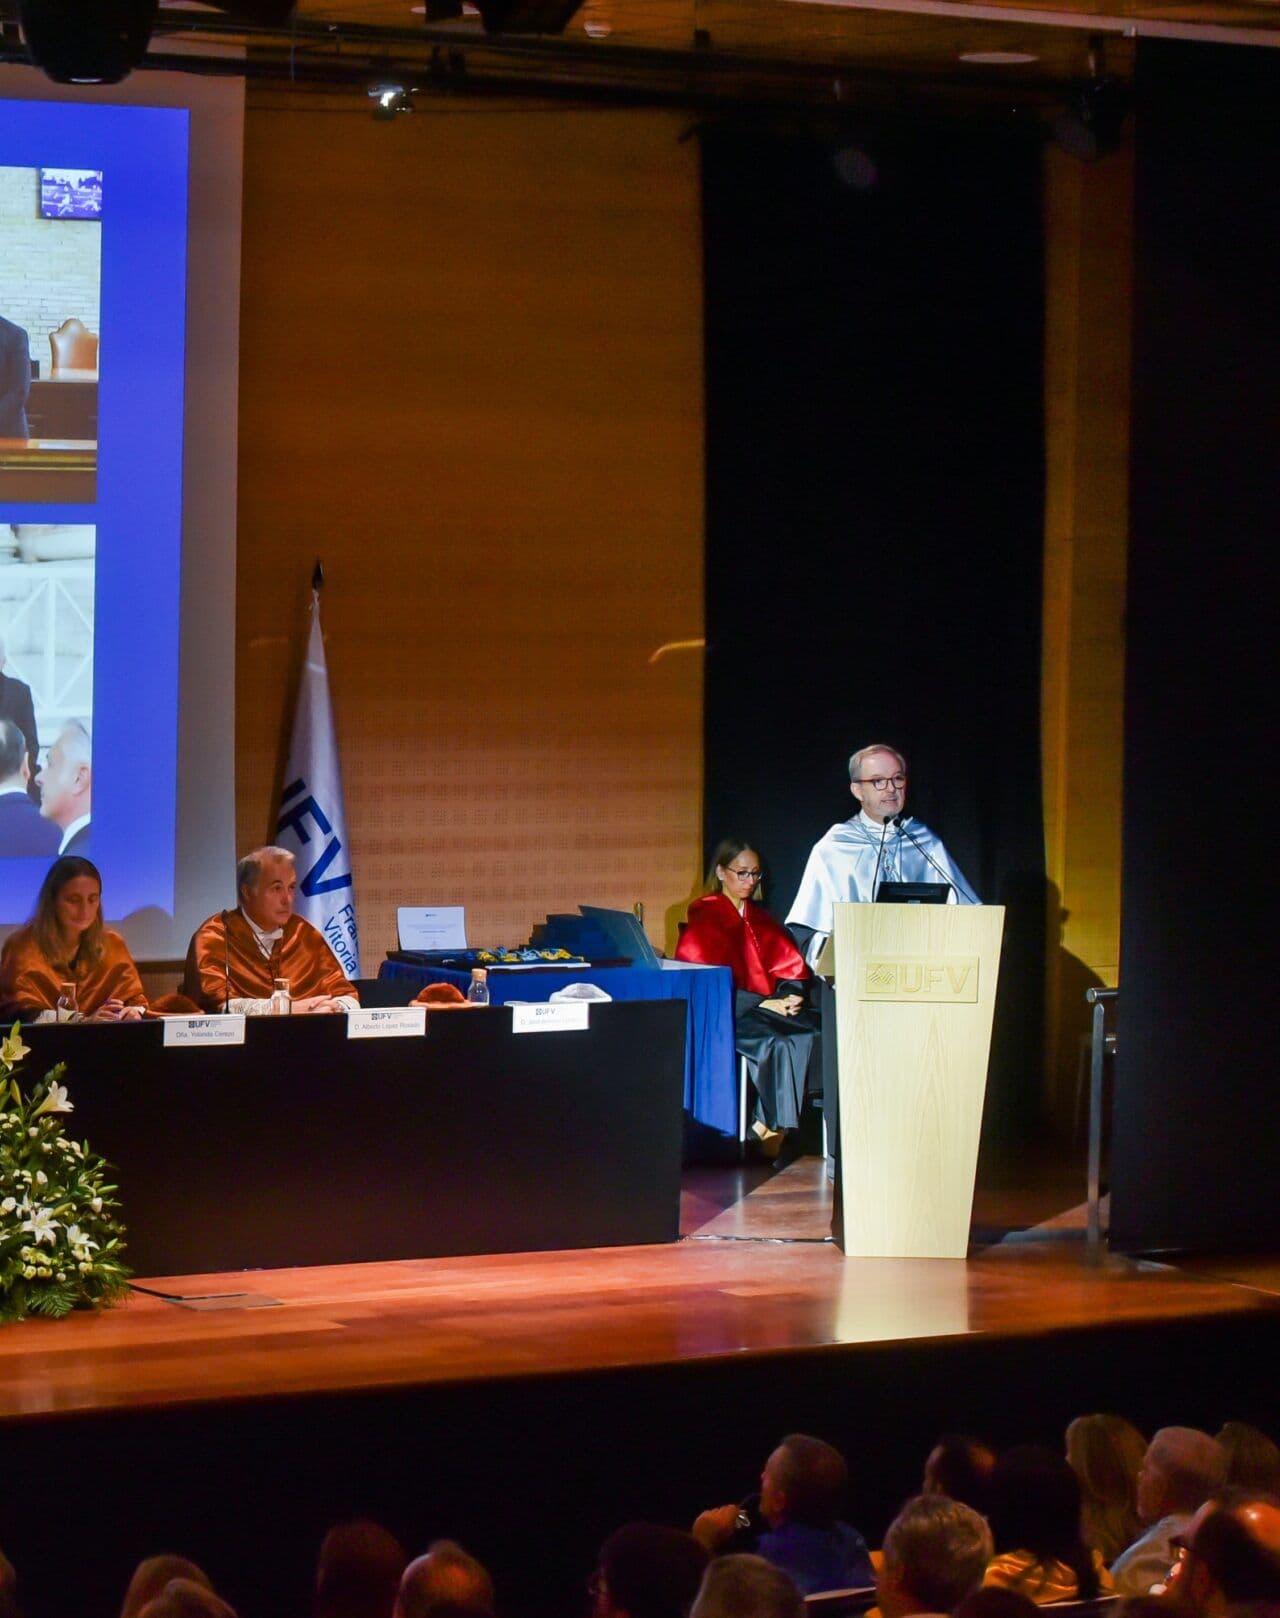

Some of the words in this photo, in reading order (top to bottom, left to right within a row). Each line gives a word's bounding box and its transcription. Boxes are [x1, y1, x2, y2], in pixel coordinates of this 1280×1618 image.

[324, 916, 357, 975] Vitoria
[900, 963, 972, 994] UFV
[194, 1020, 210, 1028] UFV
